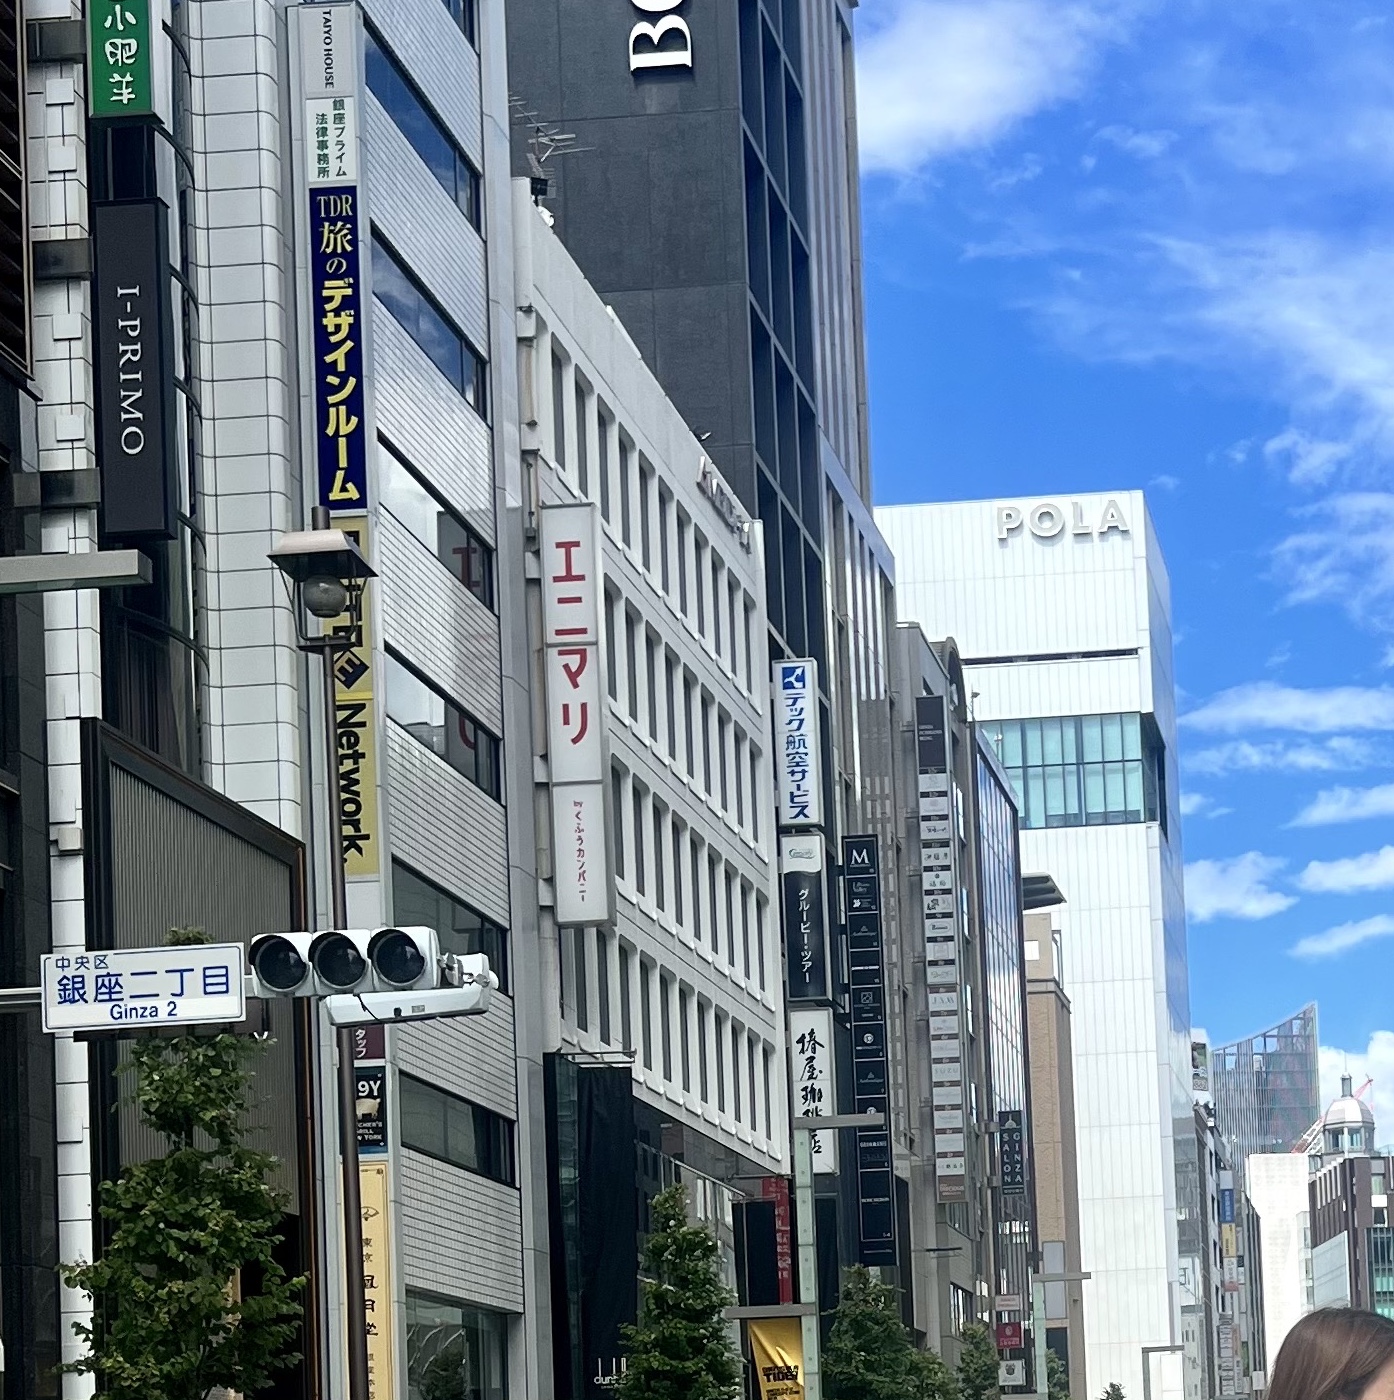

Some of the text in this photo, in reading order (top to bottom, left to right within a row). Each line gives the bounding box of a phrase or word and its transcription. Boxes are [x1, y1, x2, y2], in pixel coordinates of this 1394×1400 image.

[104, 4, 137, 105] 小肥羊
[322, 9, 335, 89] TAIYO HOUSE
[629, 0, 692, 71] B
[316, 113, 330, 179] 法律事務所
[332, 98, 347, 177] 銀座プライム
[316, 194, 353, 218] TDR
[116, 284, 145, 456] I-PRIMO
[319, 220, 361, 502] 旅のデザインルーム
[997, 499, 1131, 541] POLA
[552, 540, 588, 745] エニマリ
[784, 692, 811, 820] テック航空サービス
[574, 811, 586, 902] くふうカンパニー
[851, 848, 869, 864] M
[55, 955, 110, 972] 中央区
[57, 965, 230, 1006] 銀座二丁目
[110, 1000, 178, 1021] Ginza 2
[1002, 1132, 1012, 1183] SALON
[1012, 1131, 1023, 1183] GINZA
